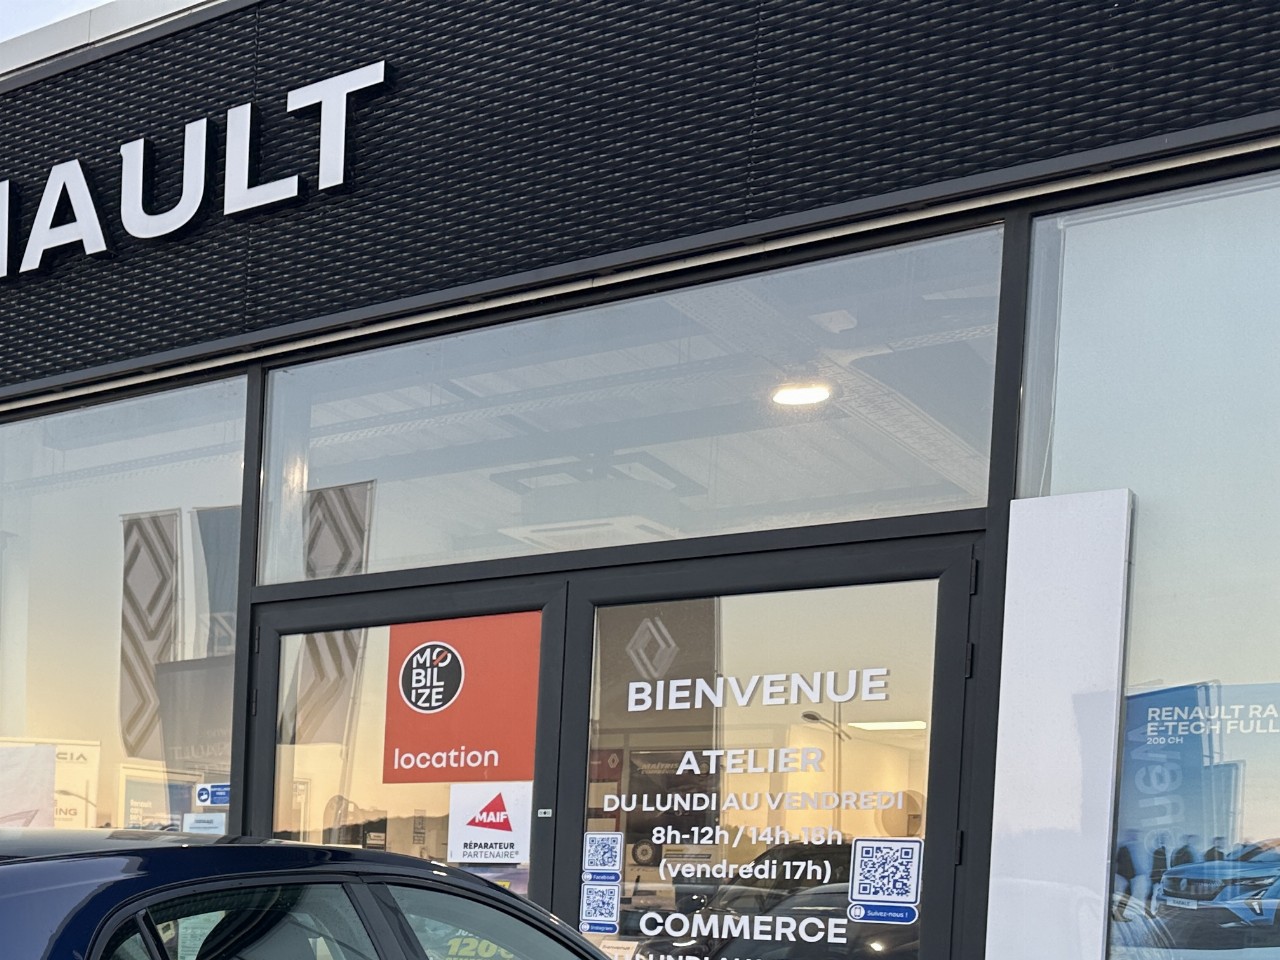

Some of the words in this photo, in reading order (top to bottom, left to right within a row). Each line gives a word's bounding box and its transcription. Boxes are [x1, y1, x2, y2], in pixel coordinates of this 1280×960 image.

[411, 667, 445, 688] BIL
[411, 687, 444, 708] IZE
[627, 668, 889, 712] BIENVENUE
[1148, 705, 1245, 721] RENAULT
[1147, 720, 1221, 736] E-TECH
[1226, 719, 1280, 734] FULL
[1147, 737, 1166, 745] 200
[1168, 736, 1184, 744] CH
[394, 746, 499, 769] location
[675, 748, 824, 775] ATELIER
[603, 794, 637, 811] DU
[642, 793, 717, 811] LUNDI
[722, 793, 758, 810] AU
[766, 791, 903, 811] VENDREDI
[475, 811, 509, 824] MAIF
[463, 841, 515, 850] RÉPARATEUR
[652, 825, 729, 845] 8h-12h
[732, 826, 744, 848] /
[751, 825, 842, 846] 14h-18h
[658, 858, 777, 882] (vendredi
[782, 859, 831, 882] 17h)
[867, 909, 904, 918] Suivez-nous
[639, 911, 848, 944] COMMERCE
